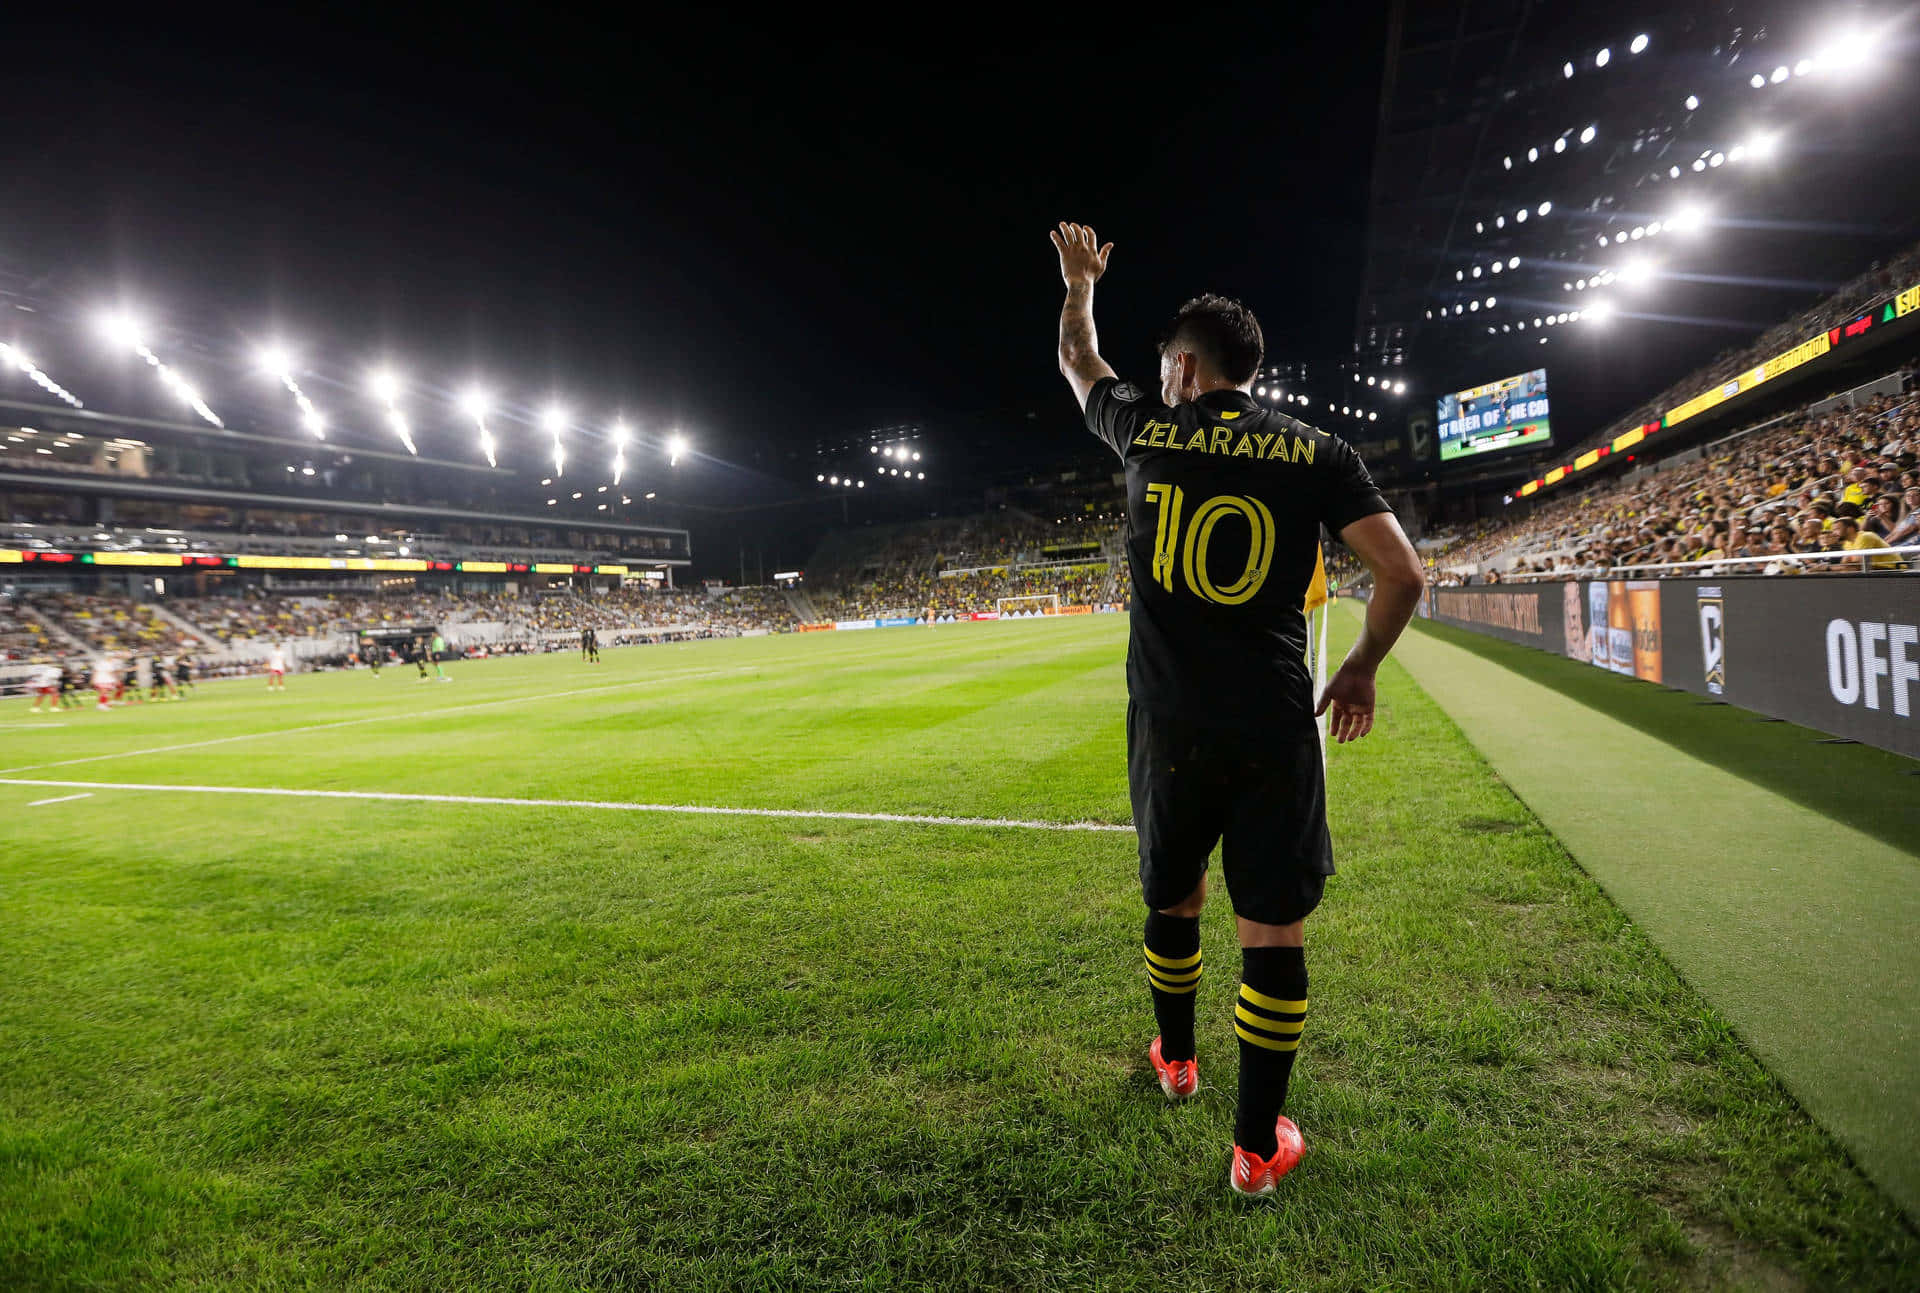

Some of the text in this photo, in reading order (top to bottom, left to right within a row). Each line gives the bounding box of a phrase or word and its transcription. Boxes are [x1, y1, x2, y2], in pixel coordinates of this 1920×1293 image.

[1133, 418, 1316, 465] ZELARAYÁN
[1482, 409, 1501, 427] OF
[1146, 482, 1276, 606] 10
[1826, 618, 1920, 717] OFF
